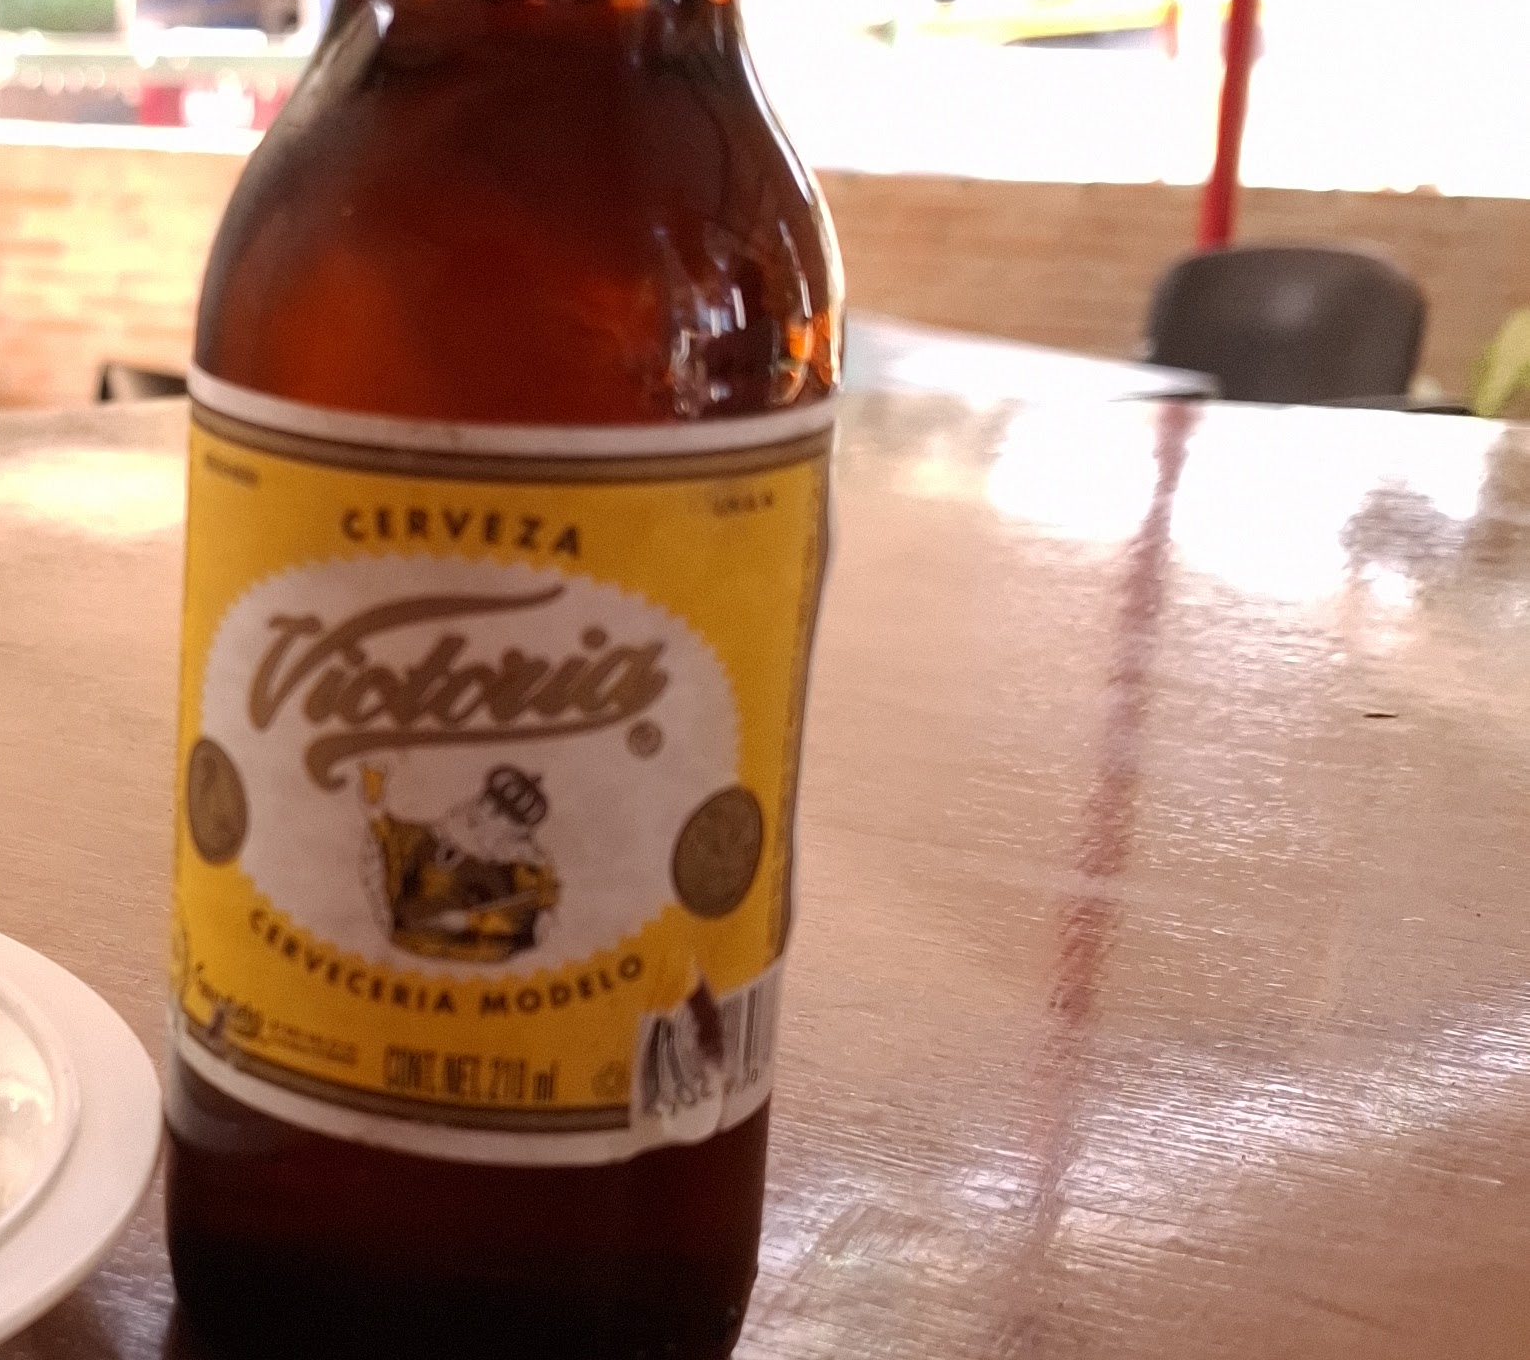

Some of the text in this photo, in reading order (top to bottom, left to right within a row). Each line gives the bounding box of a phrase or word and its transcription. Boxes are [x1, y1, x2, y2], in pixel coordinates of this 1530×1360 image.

[341, 507, 581, 559] CERVEZA
[248, 585, 669, 790] Victoria
[248, 907, 457, 1014] CERVECERIA
[479, 954, 645, 1018] MODELO
